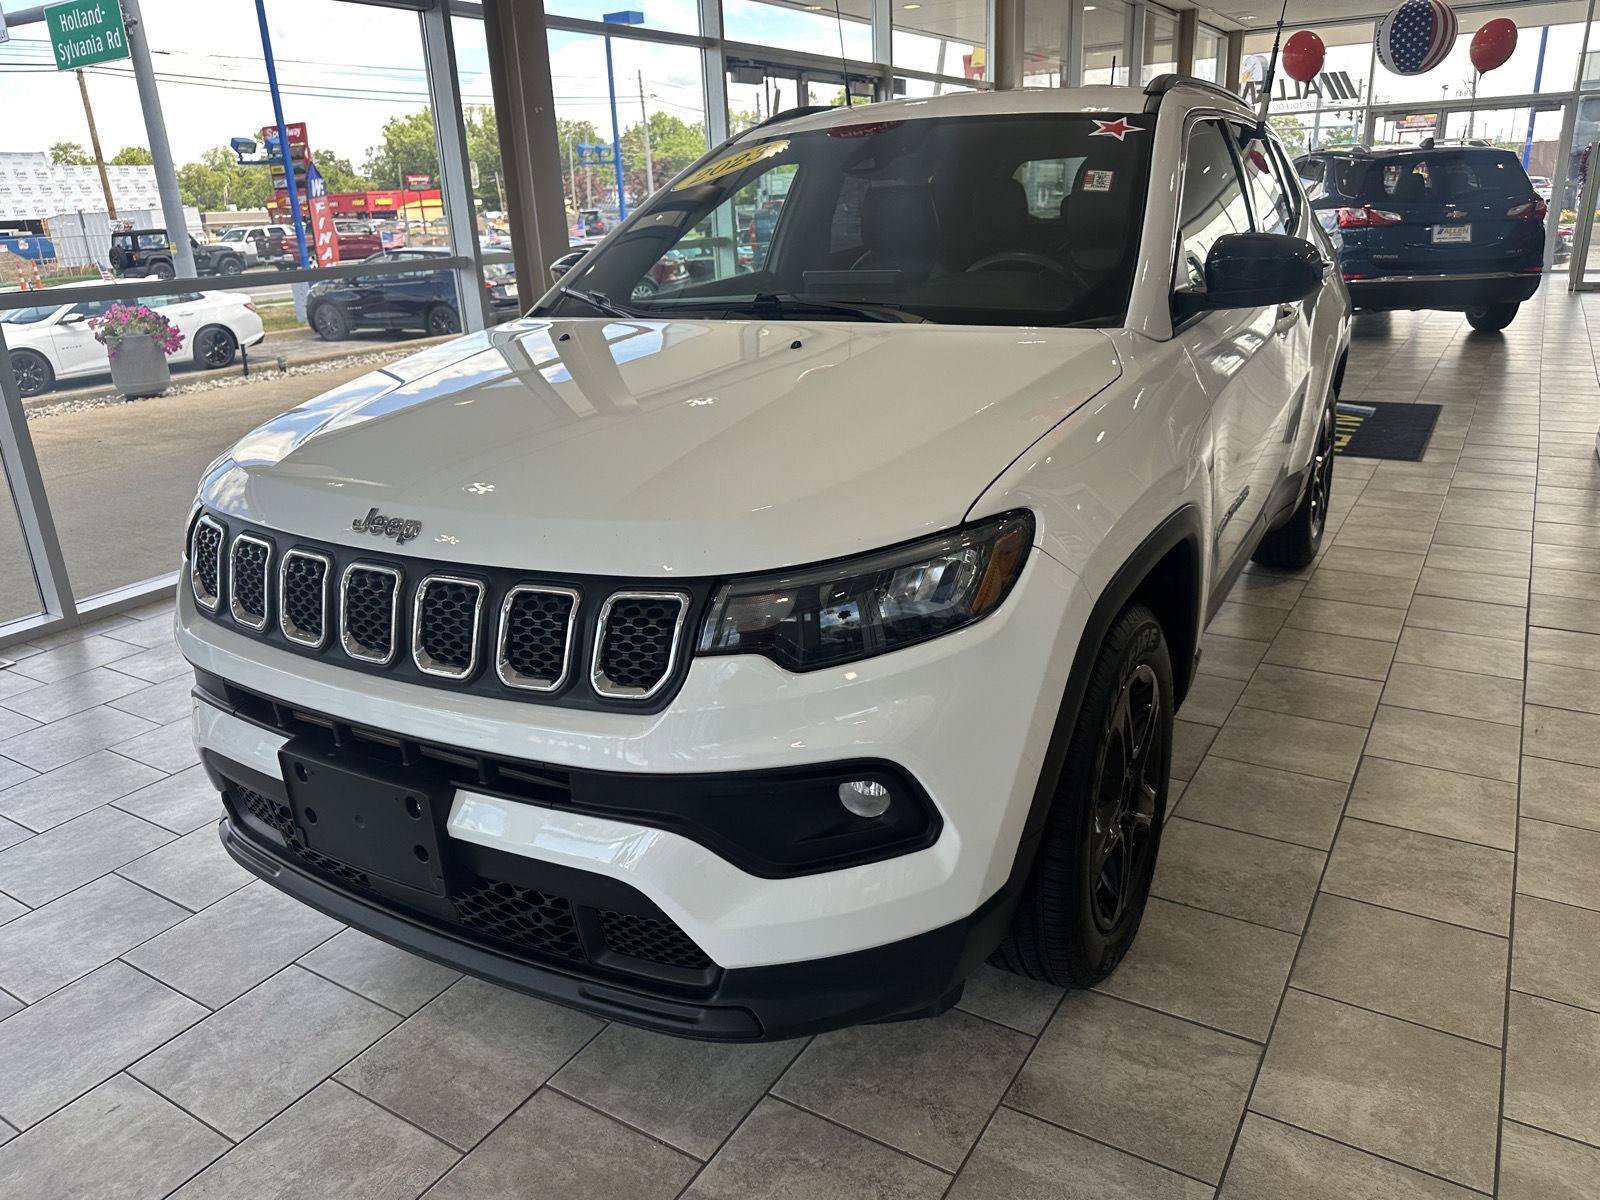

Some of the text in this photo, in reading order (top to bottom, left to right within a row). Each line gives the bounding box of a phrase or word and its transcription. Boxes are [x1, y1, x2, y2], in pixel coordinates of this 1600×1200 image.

[59, 3, 106, 32] Holland-
[58, 27, 122, 65] Sylvania Rd
[352, 507, 422, 545] Jeep
